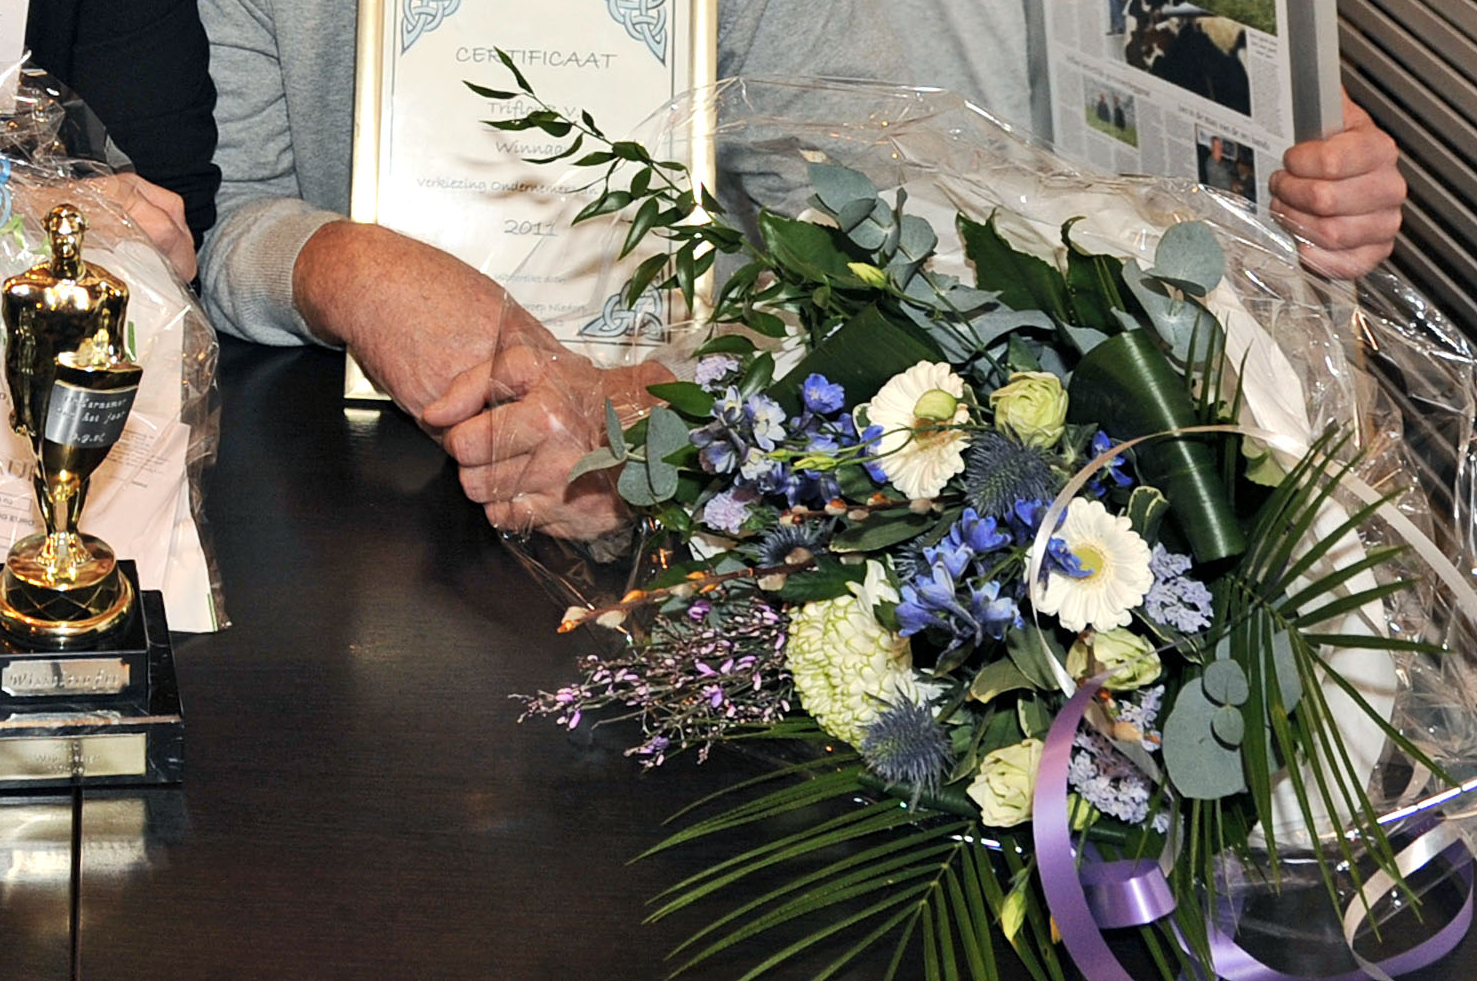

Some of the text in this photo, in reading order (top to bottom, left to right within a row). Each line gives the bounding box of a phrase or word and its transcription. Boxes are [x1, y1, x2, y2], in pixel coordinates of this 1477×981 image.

[455, 46, 618, 69] CERTIFICAAT
[495, 139, 566, 156] Winnaa
[504, 219, 558, 236] 2011
